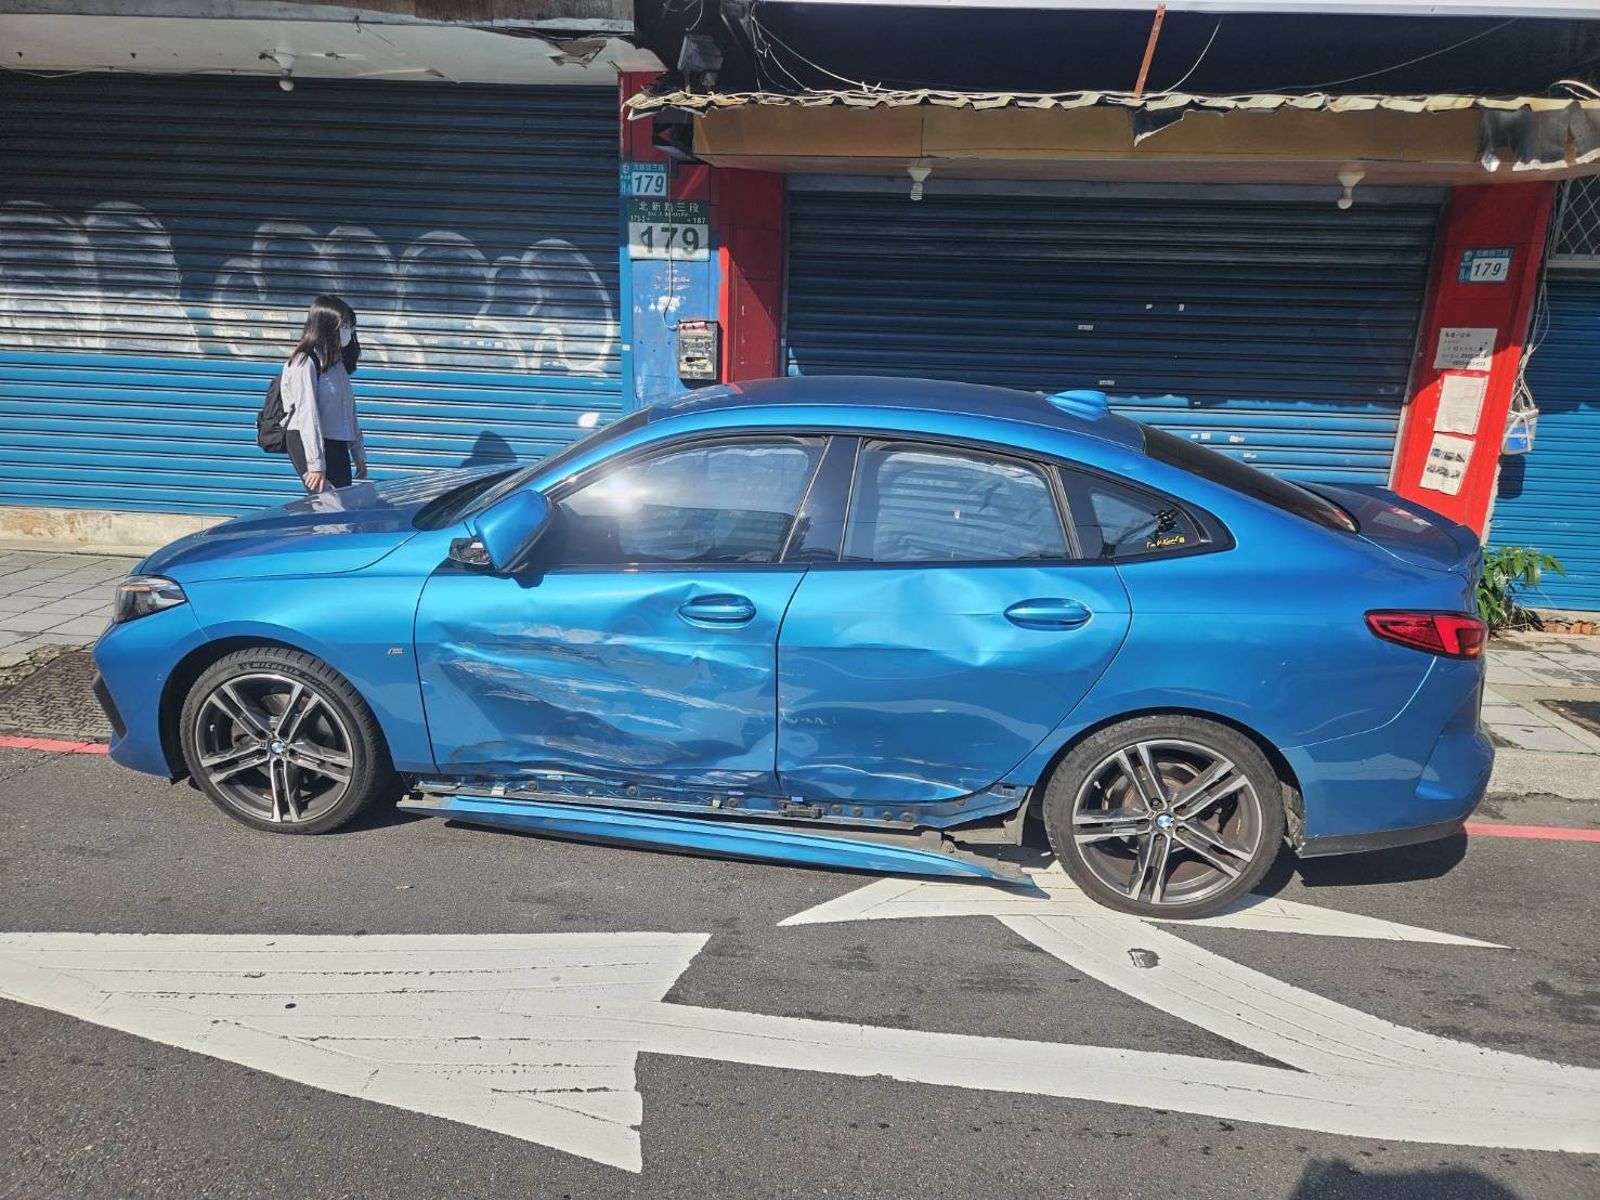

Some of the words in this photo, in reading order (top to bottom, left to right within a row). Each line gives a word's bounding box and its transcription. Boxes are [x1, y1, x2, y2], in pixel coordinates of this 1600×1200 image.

[634, 174, 664, 193] 179
[693, 217, 706, 225] 187
[640, 225, 700, 255] 179
[1475, 262, 1502, 277] 179
